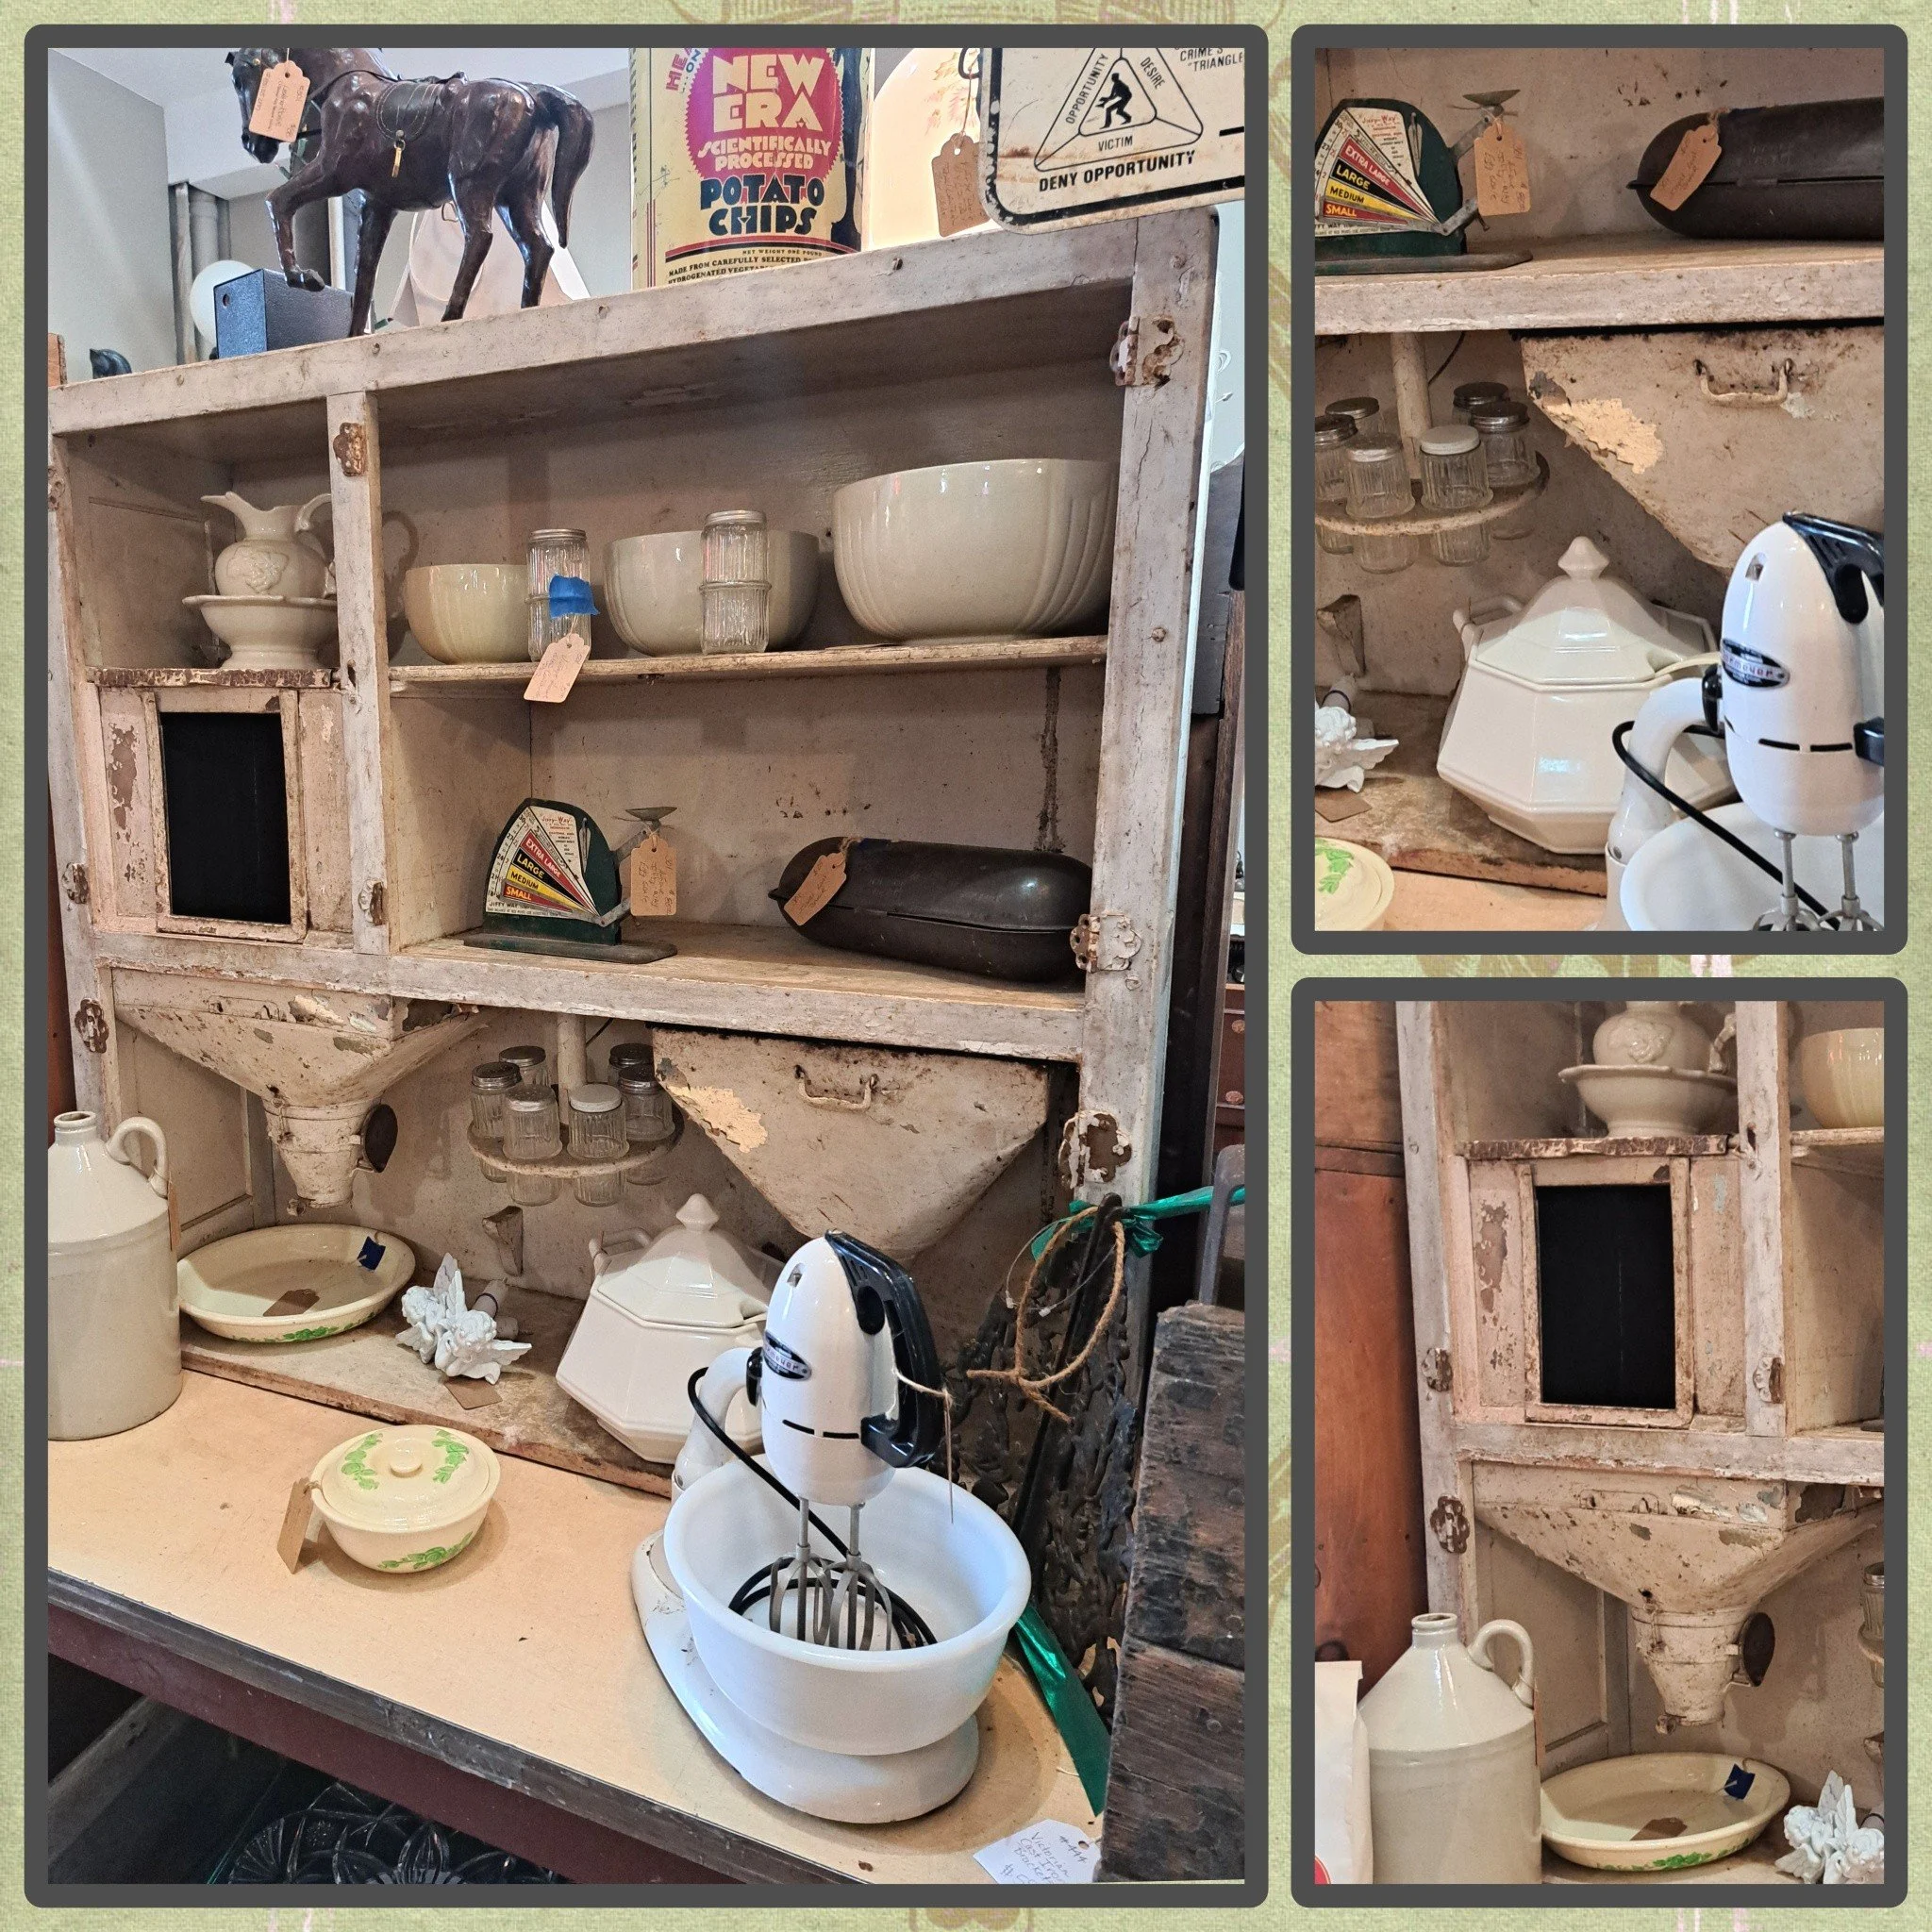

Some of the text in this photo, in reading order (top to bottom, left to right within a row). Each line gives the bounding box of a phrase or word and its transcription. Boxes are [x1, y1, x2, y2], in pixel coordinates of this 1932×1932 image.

[713, 53, 824, 97] NEW
[1140, 57, 1166, 91] DESIRE
[1065, 53, 1109, 125] OPPORTUNITY
[713, 92, 824, 133] ERA
[698, 135, 832, 158] SCIENTIFICALLY
[1097, 135, 1134, 153] VICTIM
[715, 152, 814, 173] PROCESSED
[1039, 149, 1196, 192] DENY OPPORTUNITY
[1344, 144, 1369, 169] EXTRA
[1368, 164, 1391, 187] LARGE
[700, 172, 825, 210] POTATO
[1336, 164, 1371, 191] LARGE
[1329, 186, 1365, 204] MEDIUM
[708, 204, 818, 237] CHIPS
[1325, 203, 1357, 217] SMALL
[668, 265, 687, 277] MADE
[689, 261, 708, 272] FROM
[711, 256, 758, 267] CAREFULLY
[517, 854, 545, 879] LARGE
[525, 837, 545, 860] EXTRA
[543, 857, 561, 878] LARGE
[506, 886, 532, 901] SMALL
[510, 871, 539, 891] MEDIUM
[1020, 1838, 1041, 1859] Cast
[1031, 1831, 1070, 1878] Victorian
